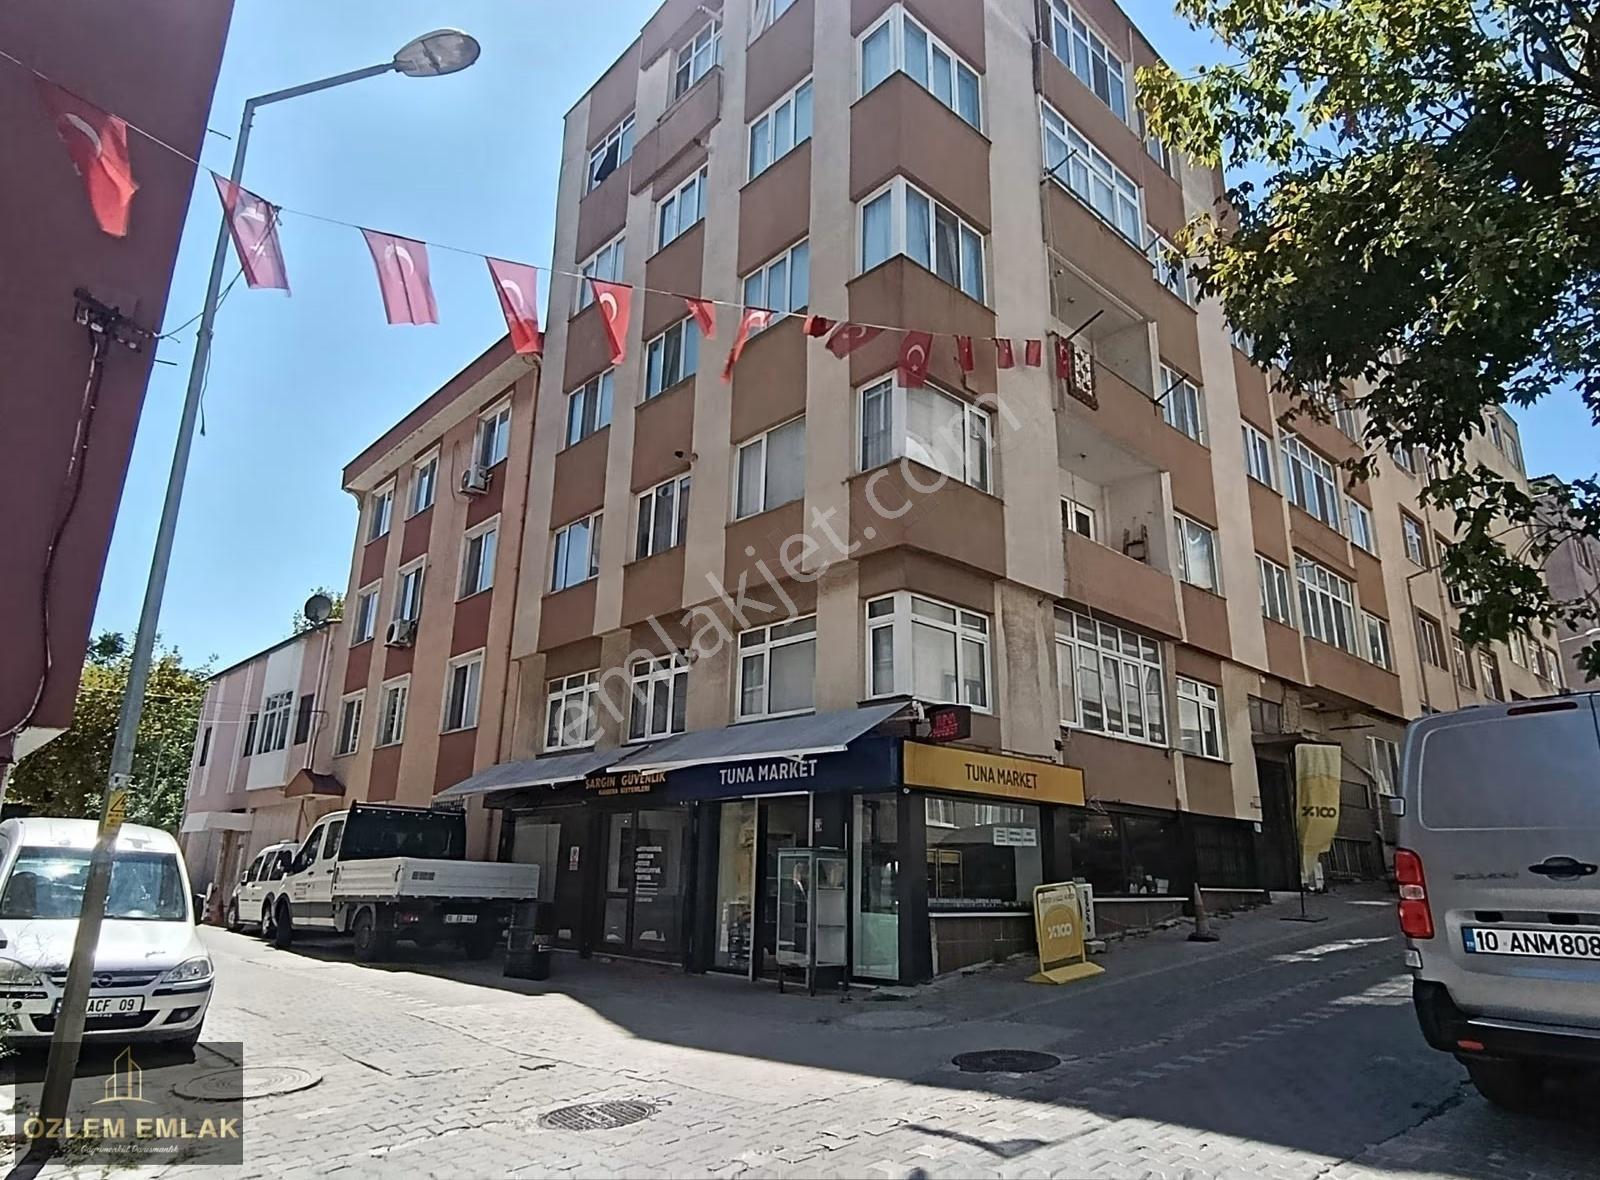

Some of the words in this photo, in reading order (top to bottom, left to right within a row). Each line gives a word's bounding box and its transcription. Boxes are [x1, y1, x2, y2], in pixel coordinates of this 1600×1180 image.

[719, 766, 755, 786] TUNA
[758, 759, 818, 782] MARKET
[964, 763, 996, 784] TUNA
[997, 767, 1038, 790] MARKET
[1301, 806, 1337, 818] %100
[1047, 922, 1074, 940] %100
[1476, 931, 1498, 951] 10
[87, 999, 112, 1013] ACF
[119, 998, 135, 1011] 09
